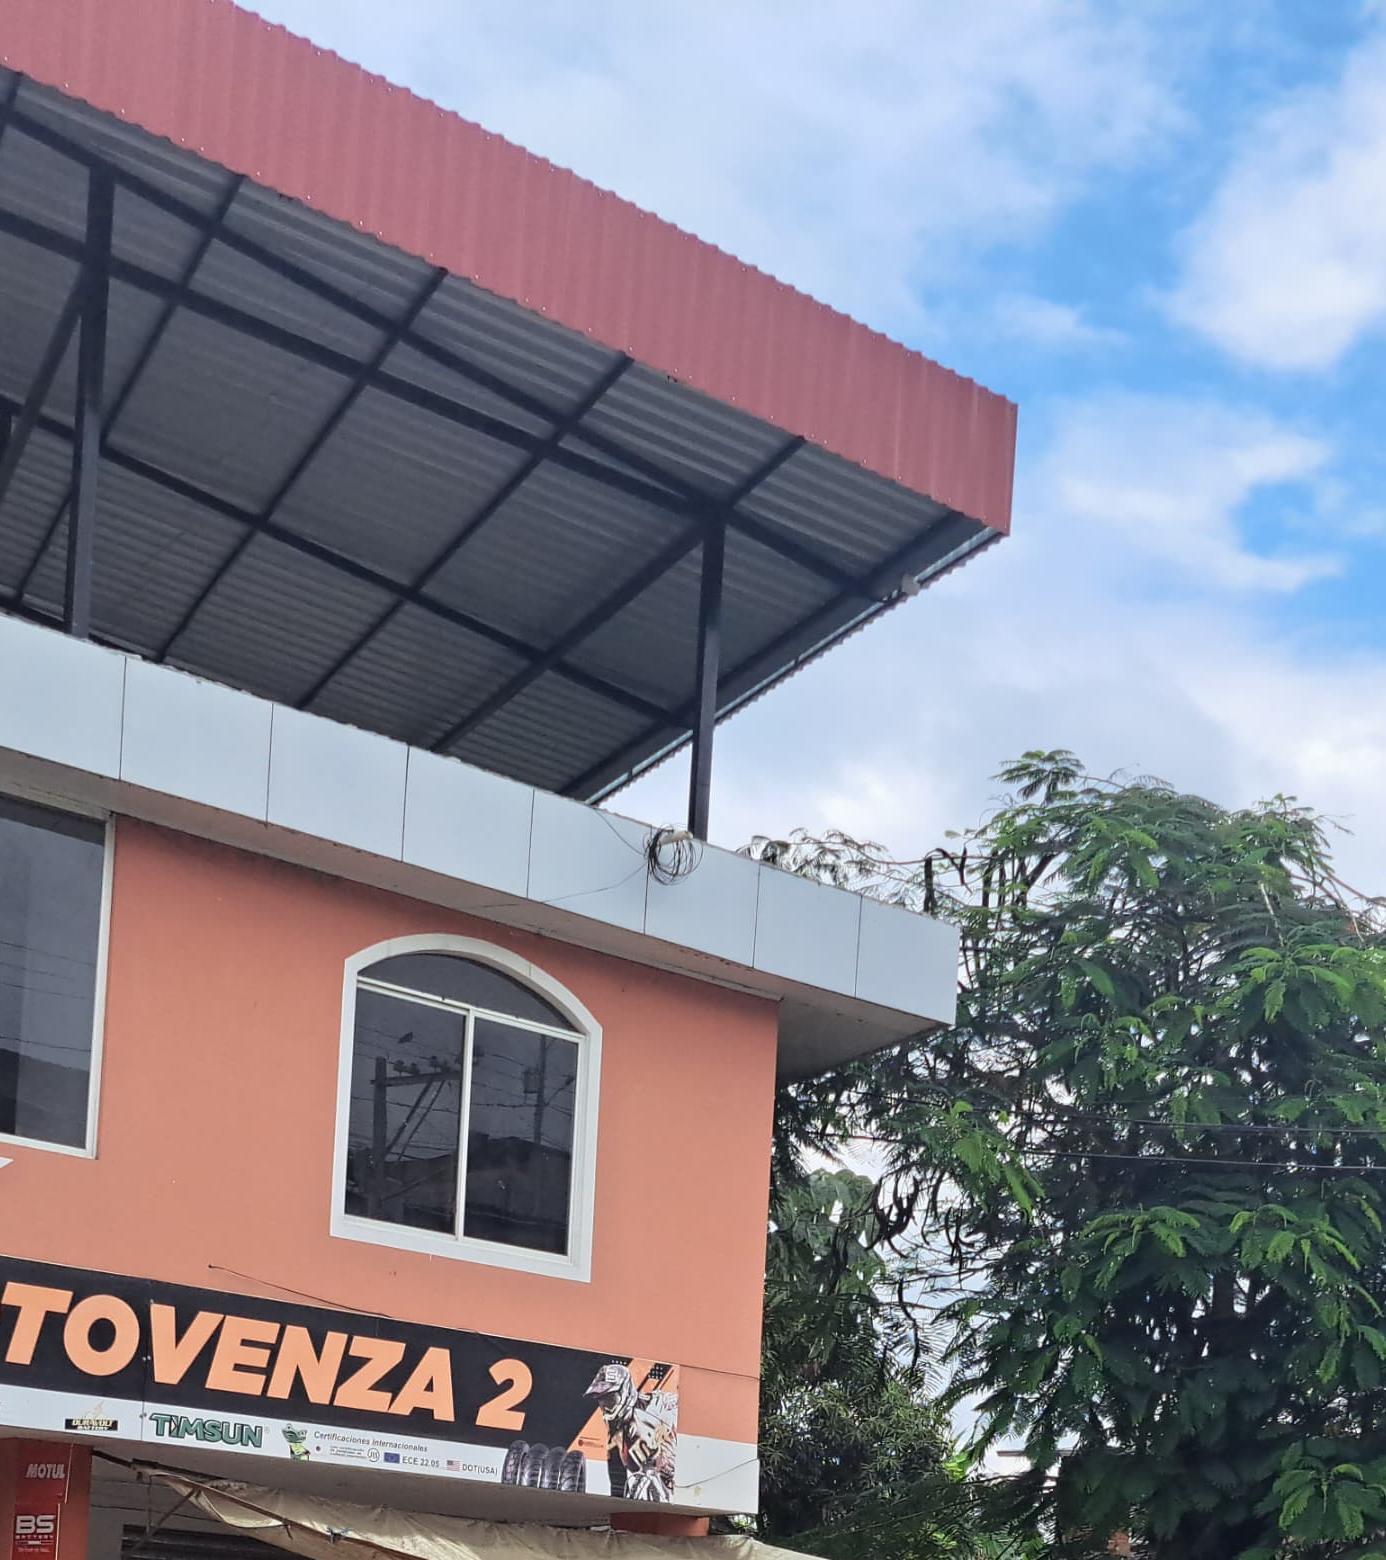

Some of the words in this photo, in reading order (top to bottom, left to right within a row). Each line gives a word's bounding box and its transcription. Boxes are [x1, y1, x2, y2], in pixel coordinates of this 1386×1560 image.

[476, 1359, 533, 1431] 2
[149, 1413, 263, 1447] TIMSUN
[314, 1431, 370, 1445] Certificaciones
[402, 1456, 419, 1465] ECE
[25, 1463, 66, 1479] MOTUL
[15, 1514, 55, 1533] BS
